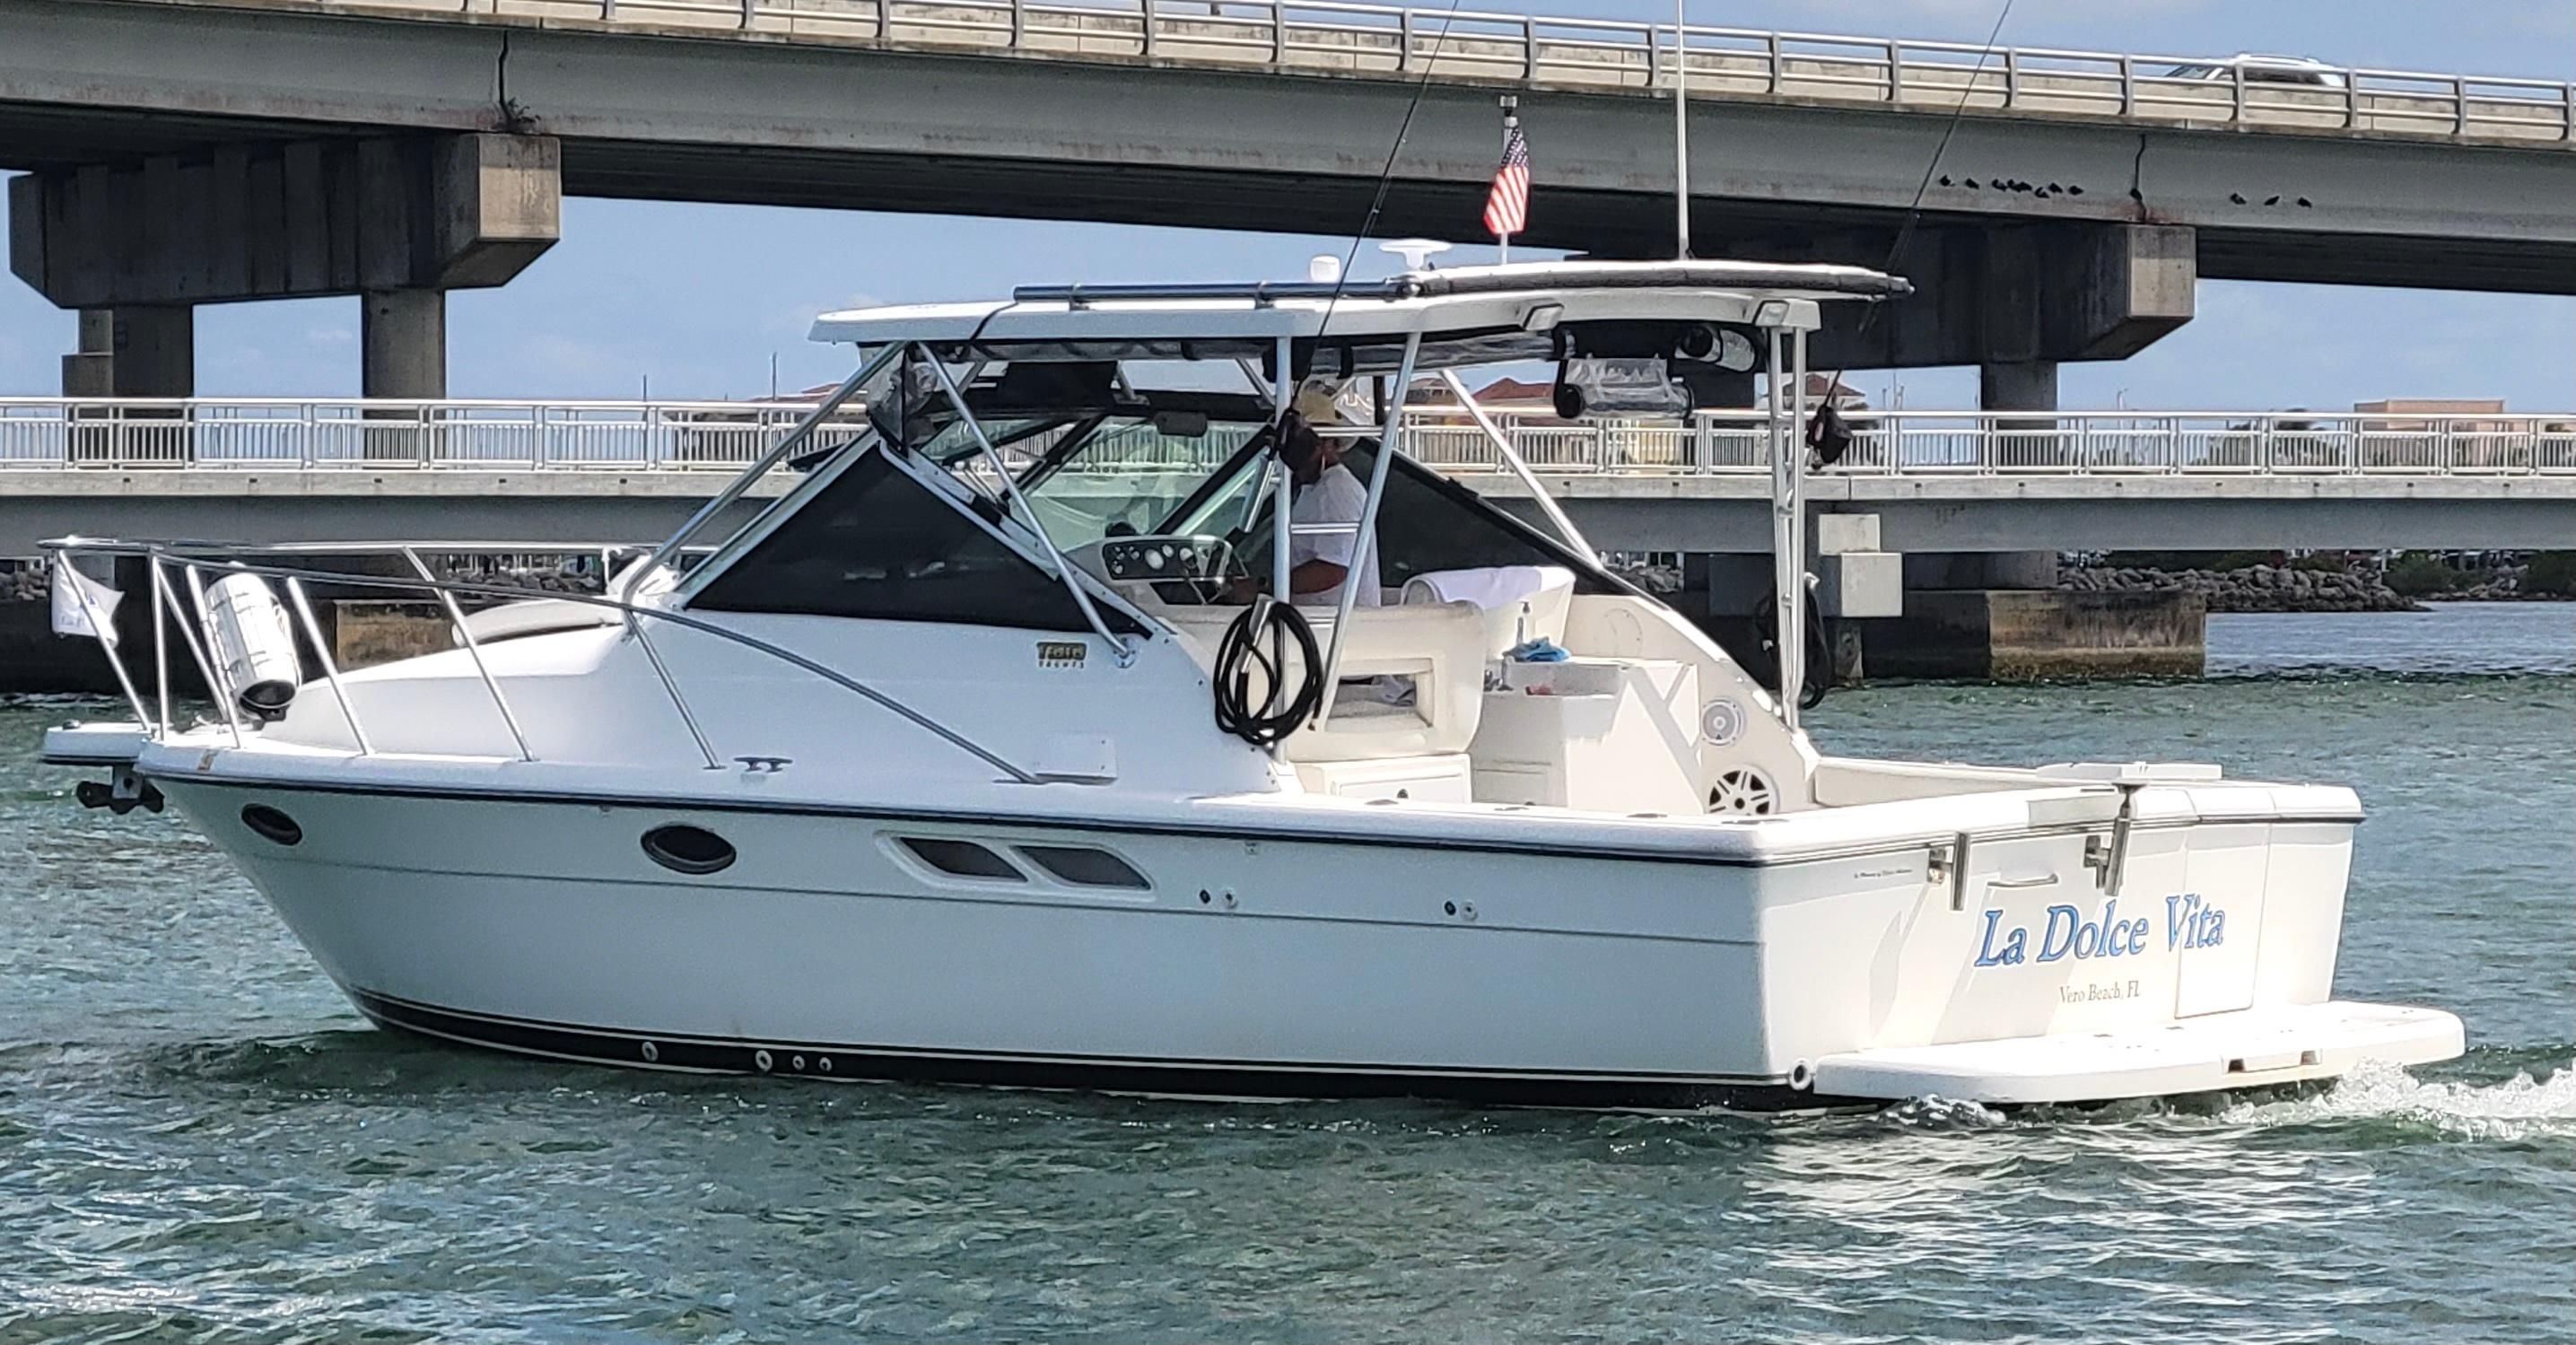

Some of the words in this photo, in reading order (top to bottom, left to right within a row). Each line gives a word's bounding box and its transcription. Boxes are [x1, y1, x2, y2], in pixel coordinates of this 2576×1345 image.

[1974, 909, 2028, 967] La
[2036, 898, 2149, 963] Dolce
[2165, 894, 2226, 952] Vita
[2060, 985, 2085, 1003] Vero
